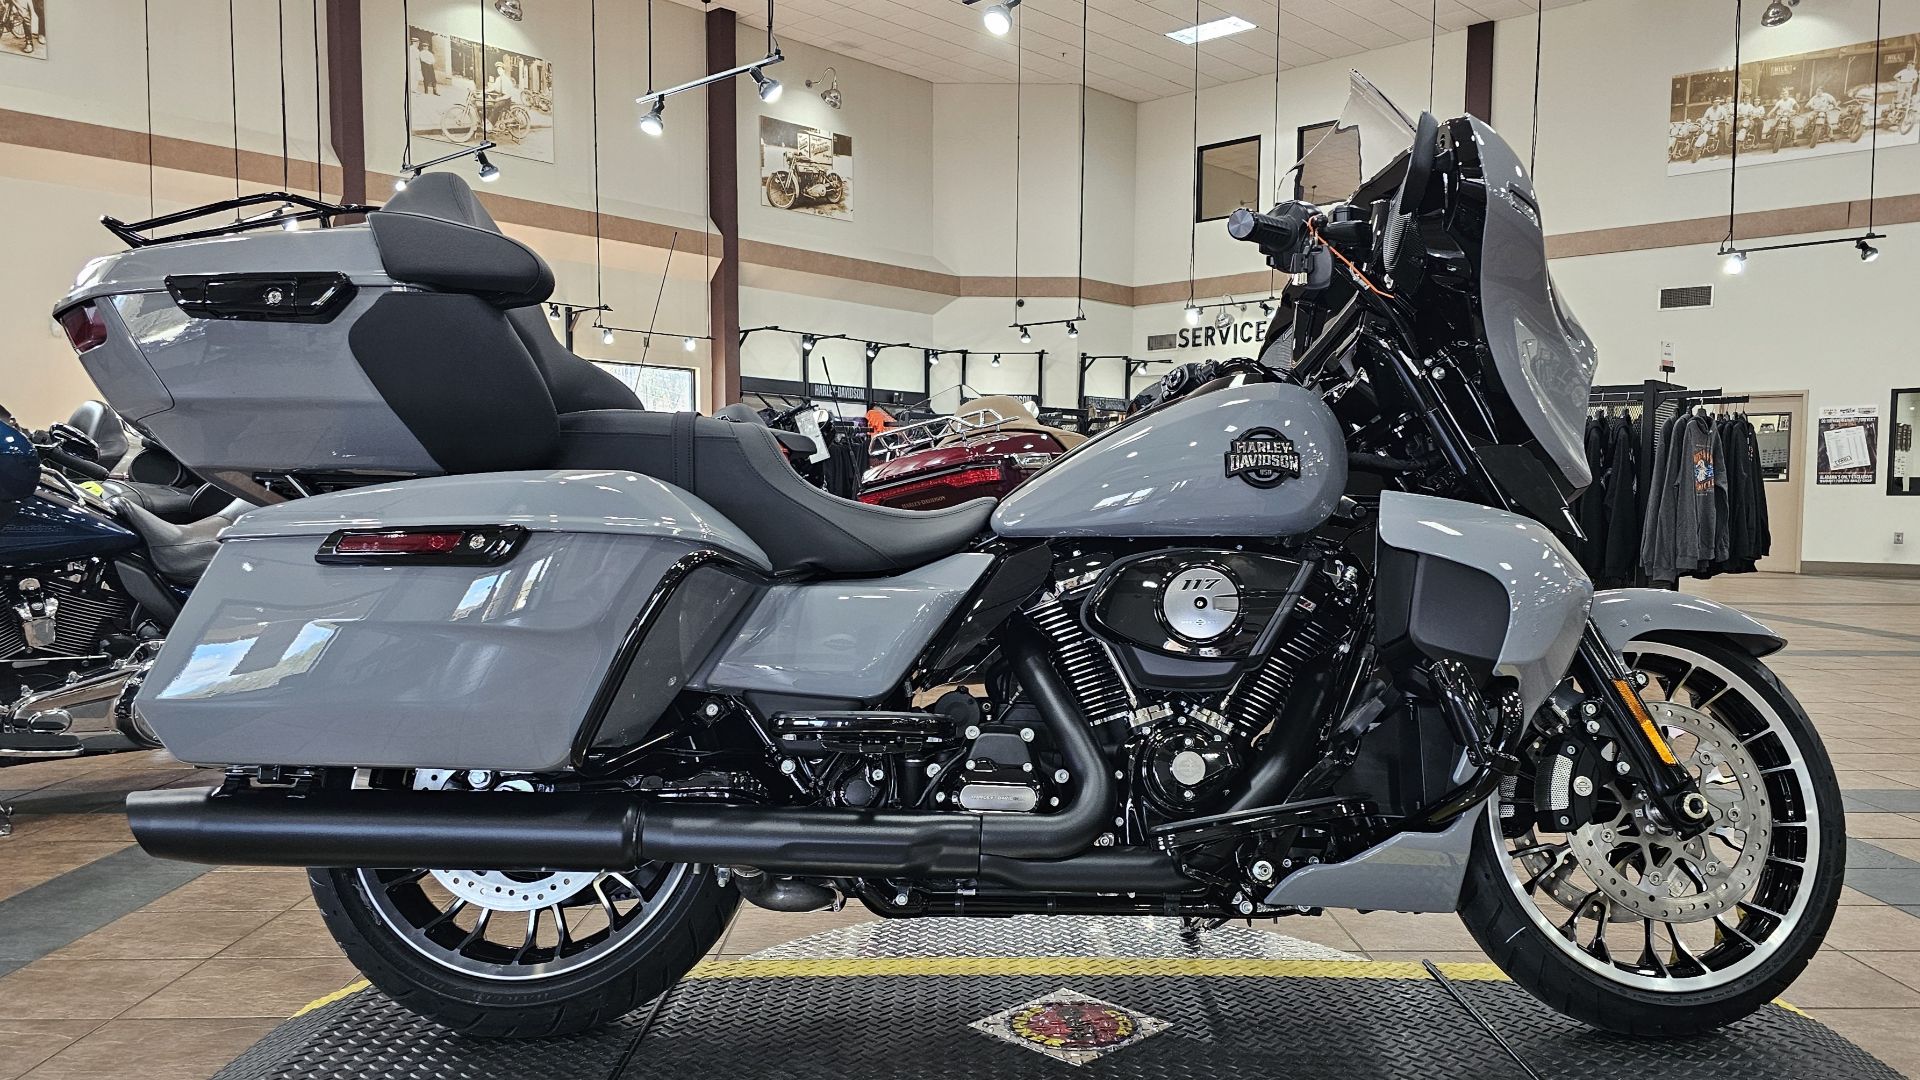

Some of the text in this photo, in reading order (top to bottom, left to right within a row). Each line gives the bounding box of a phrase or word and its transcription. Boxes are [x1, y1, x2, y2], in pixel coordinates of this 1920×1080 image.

[1178, 320, 1267, 348] SERVICE
[814, 384, 865, 400] HARLEY-DAVIDSON
[1230, 454, 1299, 472] DAVIDSON
[901, 495, 946, 509] HARLEY-DAVIDSON
[1180, 577, 1223, 592] 117
